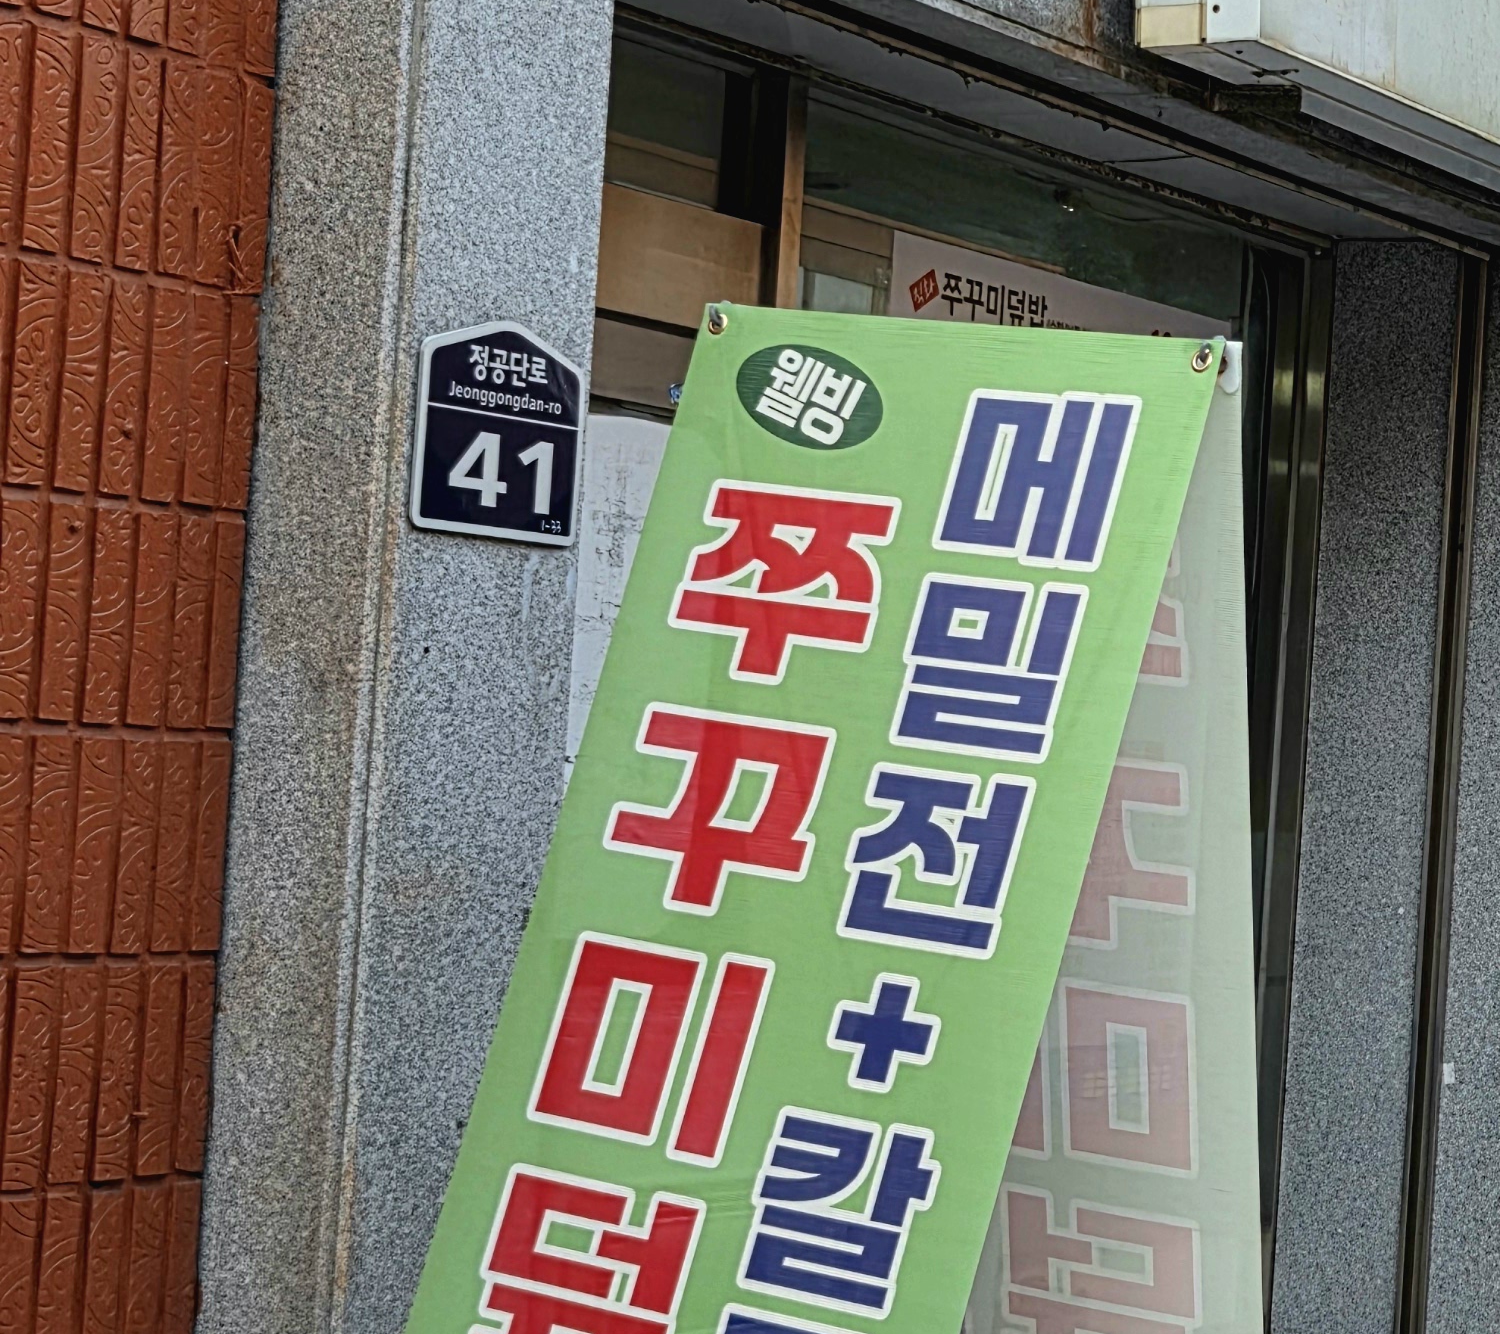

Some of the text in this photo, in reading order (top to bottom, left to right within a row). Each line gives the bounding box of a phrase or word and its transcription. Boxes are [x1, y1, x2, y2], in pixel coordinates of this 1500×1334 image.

[941, 272, 1047, 327] 쭈꾸미덮밥
[470, 345, 548, 387] 정공단로
[449, 381, 562, 415] Jeonggongdan-ro
[757, 347, 866, 447] 웰빙
[448, 431, 555, 515] 41
